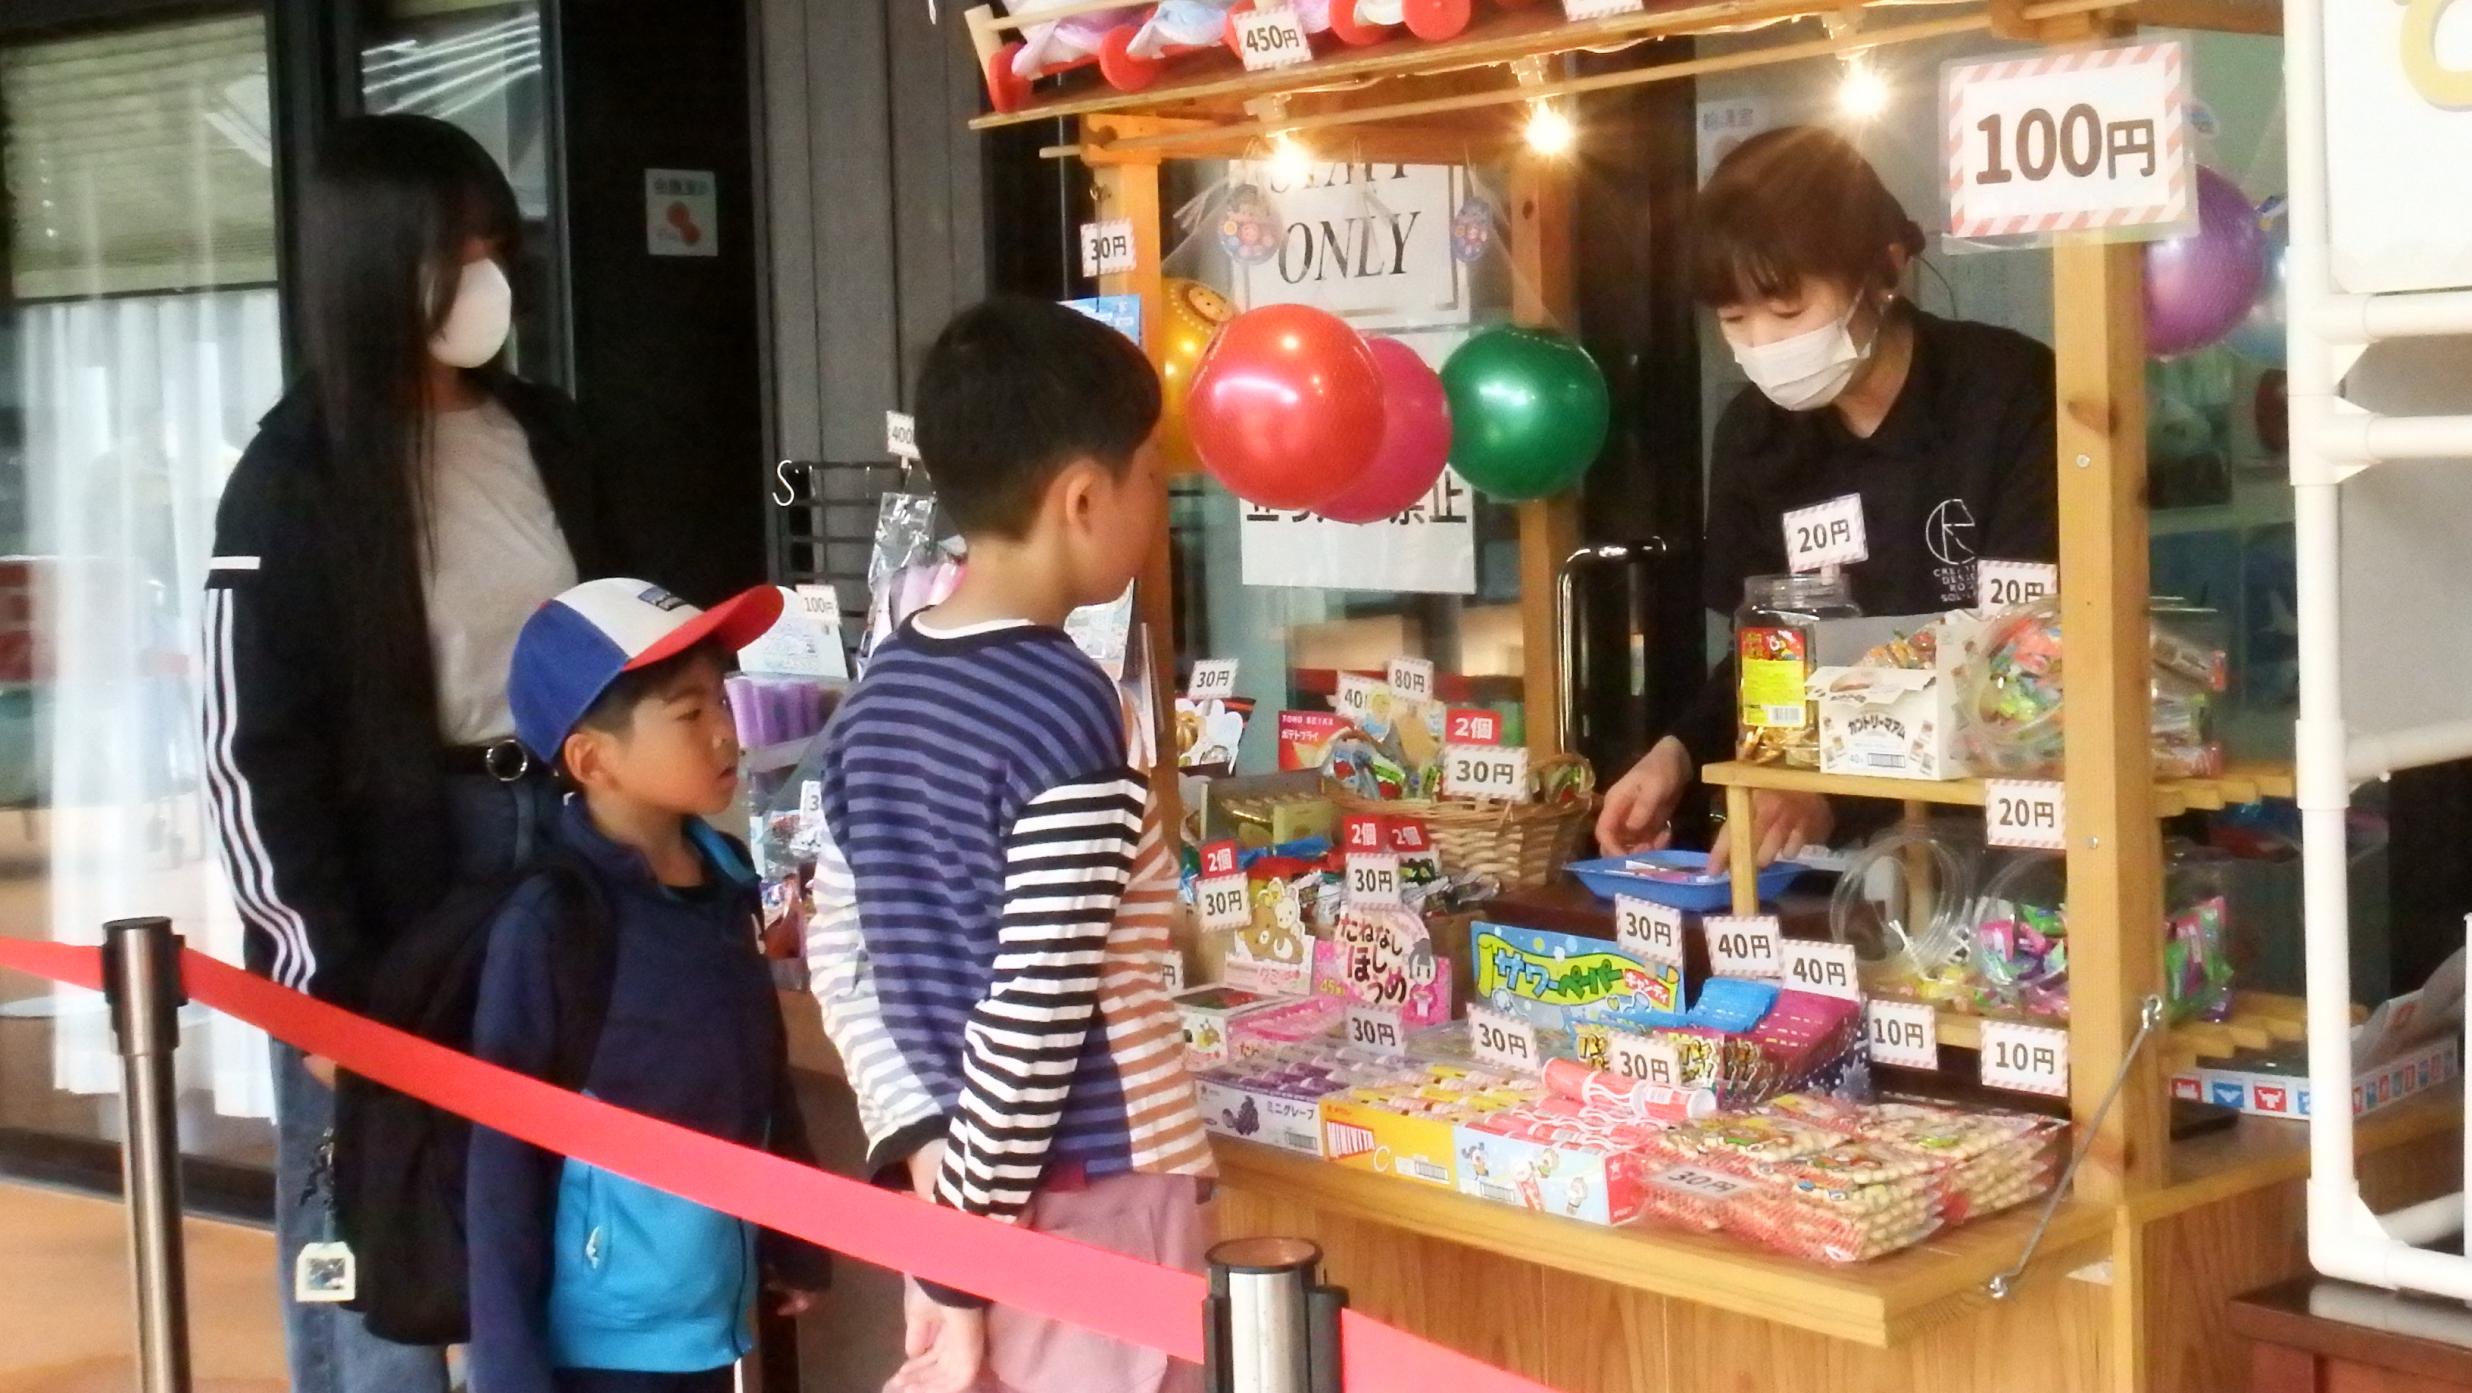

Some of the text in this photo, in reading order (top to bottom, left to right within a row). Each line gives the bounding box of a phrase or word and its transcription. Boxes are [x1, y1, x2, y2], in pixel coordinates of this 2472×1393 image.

[1246, 24, 1300, 53] 450円
[1974, 102, 2157, 186] 100円
[1090, 235, 1127, 260] 30円
[1278, 211, 1422, 284] ONLY
[1797, 518, 1851, 553] 20円
[1990, 578, 2045, 605] 20円
[1196, 669, 1230, 688] 30円
[1394, 668, 1426, 693] 80円
[1344, 688, 1368, 709] 40
[1454, 716, 1494, 740] 2個
[1847, 714, 1906, 740] カントリーマアム
[1456, 759, 1514, 785] 30円
[1998, 797, 2055, 828] 20円
[1351, 822, 1377, 846] 2個
[1207, 847, 1233, 872] 2個
[1354, 868, 1393, 893] 30円
[1205, 889, 1243, 916] 30円
[1340, 913, 1404, 956] たねなし
[1625, 912, 1672, 947] 30円
[1718, 933, 1771, 959] 40円
[1492, 946, 1623, 1000] サワーペーパー
[1792, 957, 1847, 987] 40円
[1352, 1017, 1396, 1047] 30円
[1478, 1023, 1527, 1059] 30円
[1873, 1017, 1924, 1049] 10円
[1619, 1051, 1670, 1083] 30円
[1995, 1041, 2054, 1075] 10円
[1266, 1100, 1315, 1119] ミニグレープ
[1668, 1170, 1738, 1193] 30円
